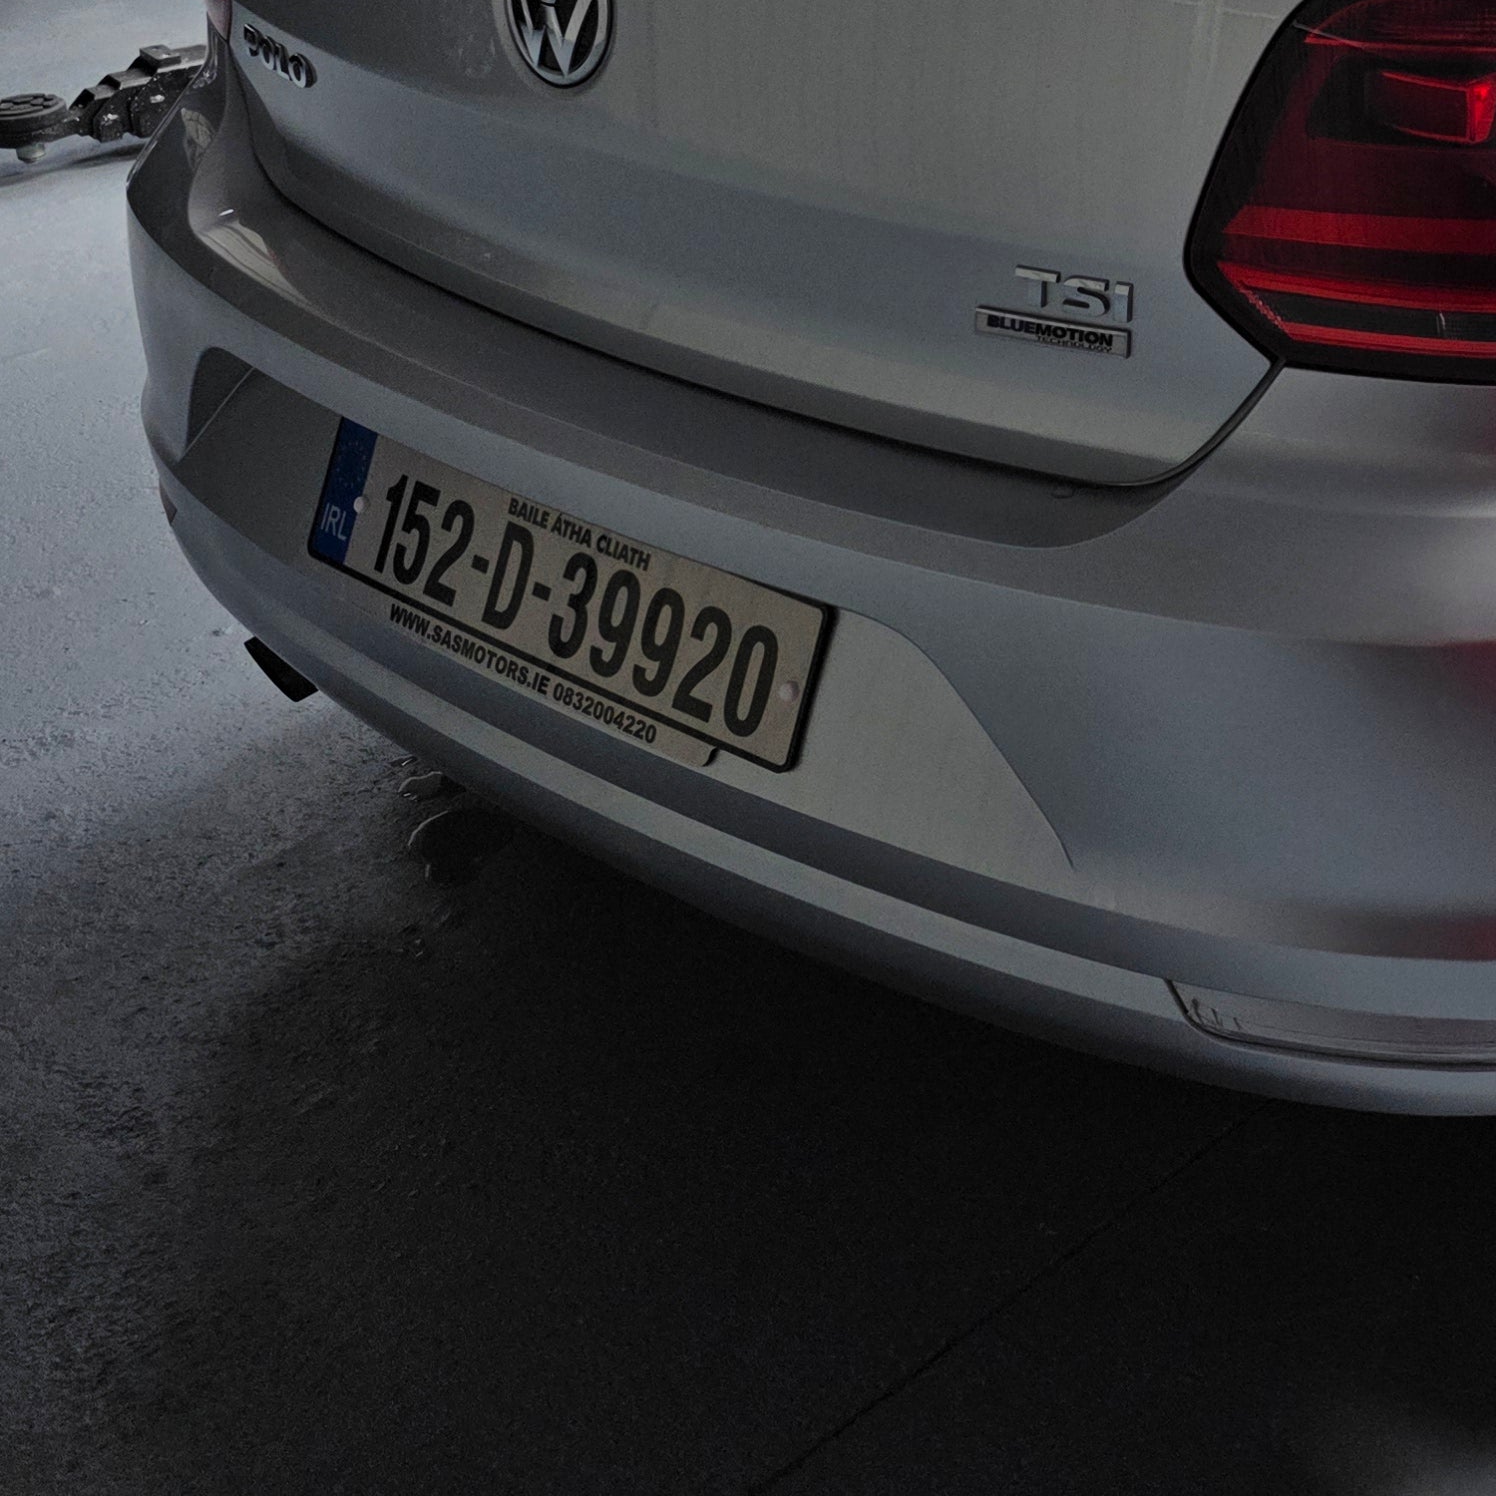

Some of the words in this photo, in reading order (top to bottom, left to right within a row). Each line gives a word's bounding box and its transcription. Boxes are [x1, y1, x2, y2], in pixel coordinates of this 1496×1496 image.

[1015, 264, 1134, 323] TSI
[987, 314, 1113, 347] BLUEMOTION
[1036, 333, 1113, 354] TECHNOLOGY
[320, 502, 347, 541] IRL
[508, 497, 550, 529] BAILE
[551, 512, 592, 548] ÁTHA
[596, 533, 651, 571] CLIATH
[374, 473, 779, 738] 152-D-39920
[389, 603, 550, 696] WWW.SASMOTORS.IE
[553, 682, 657, 744] 0832004220
